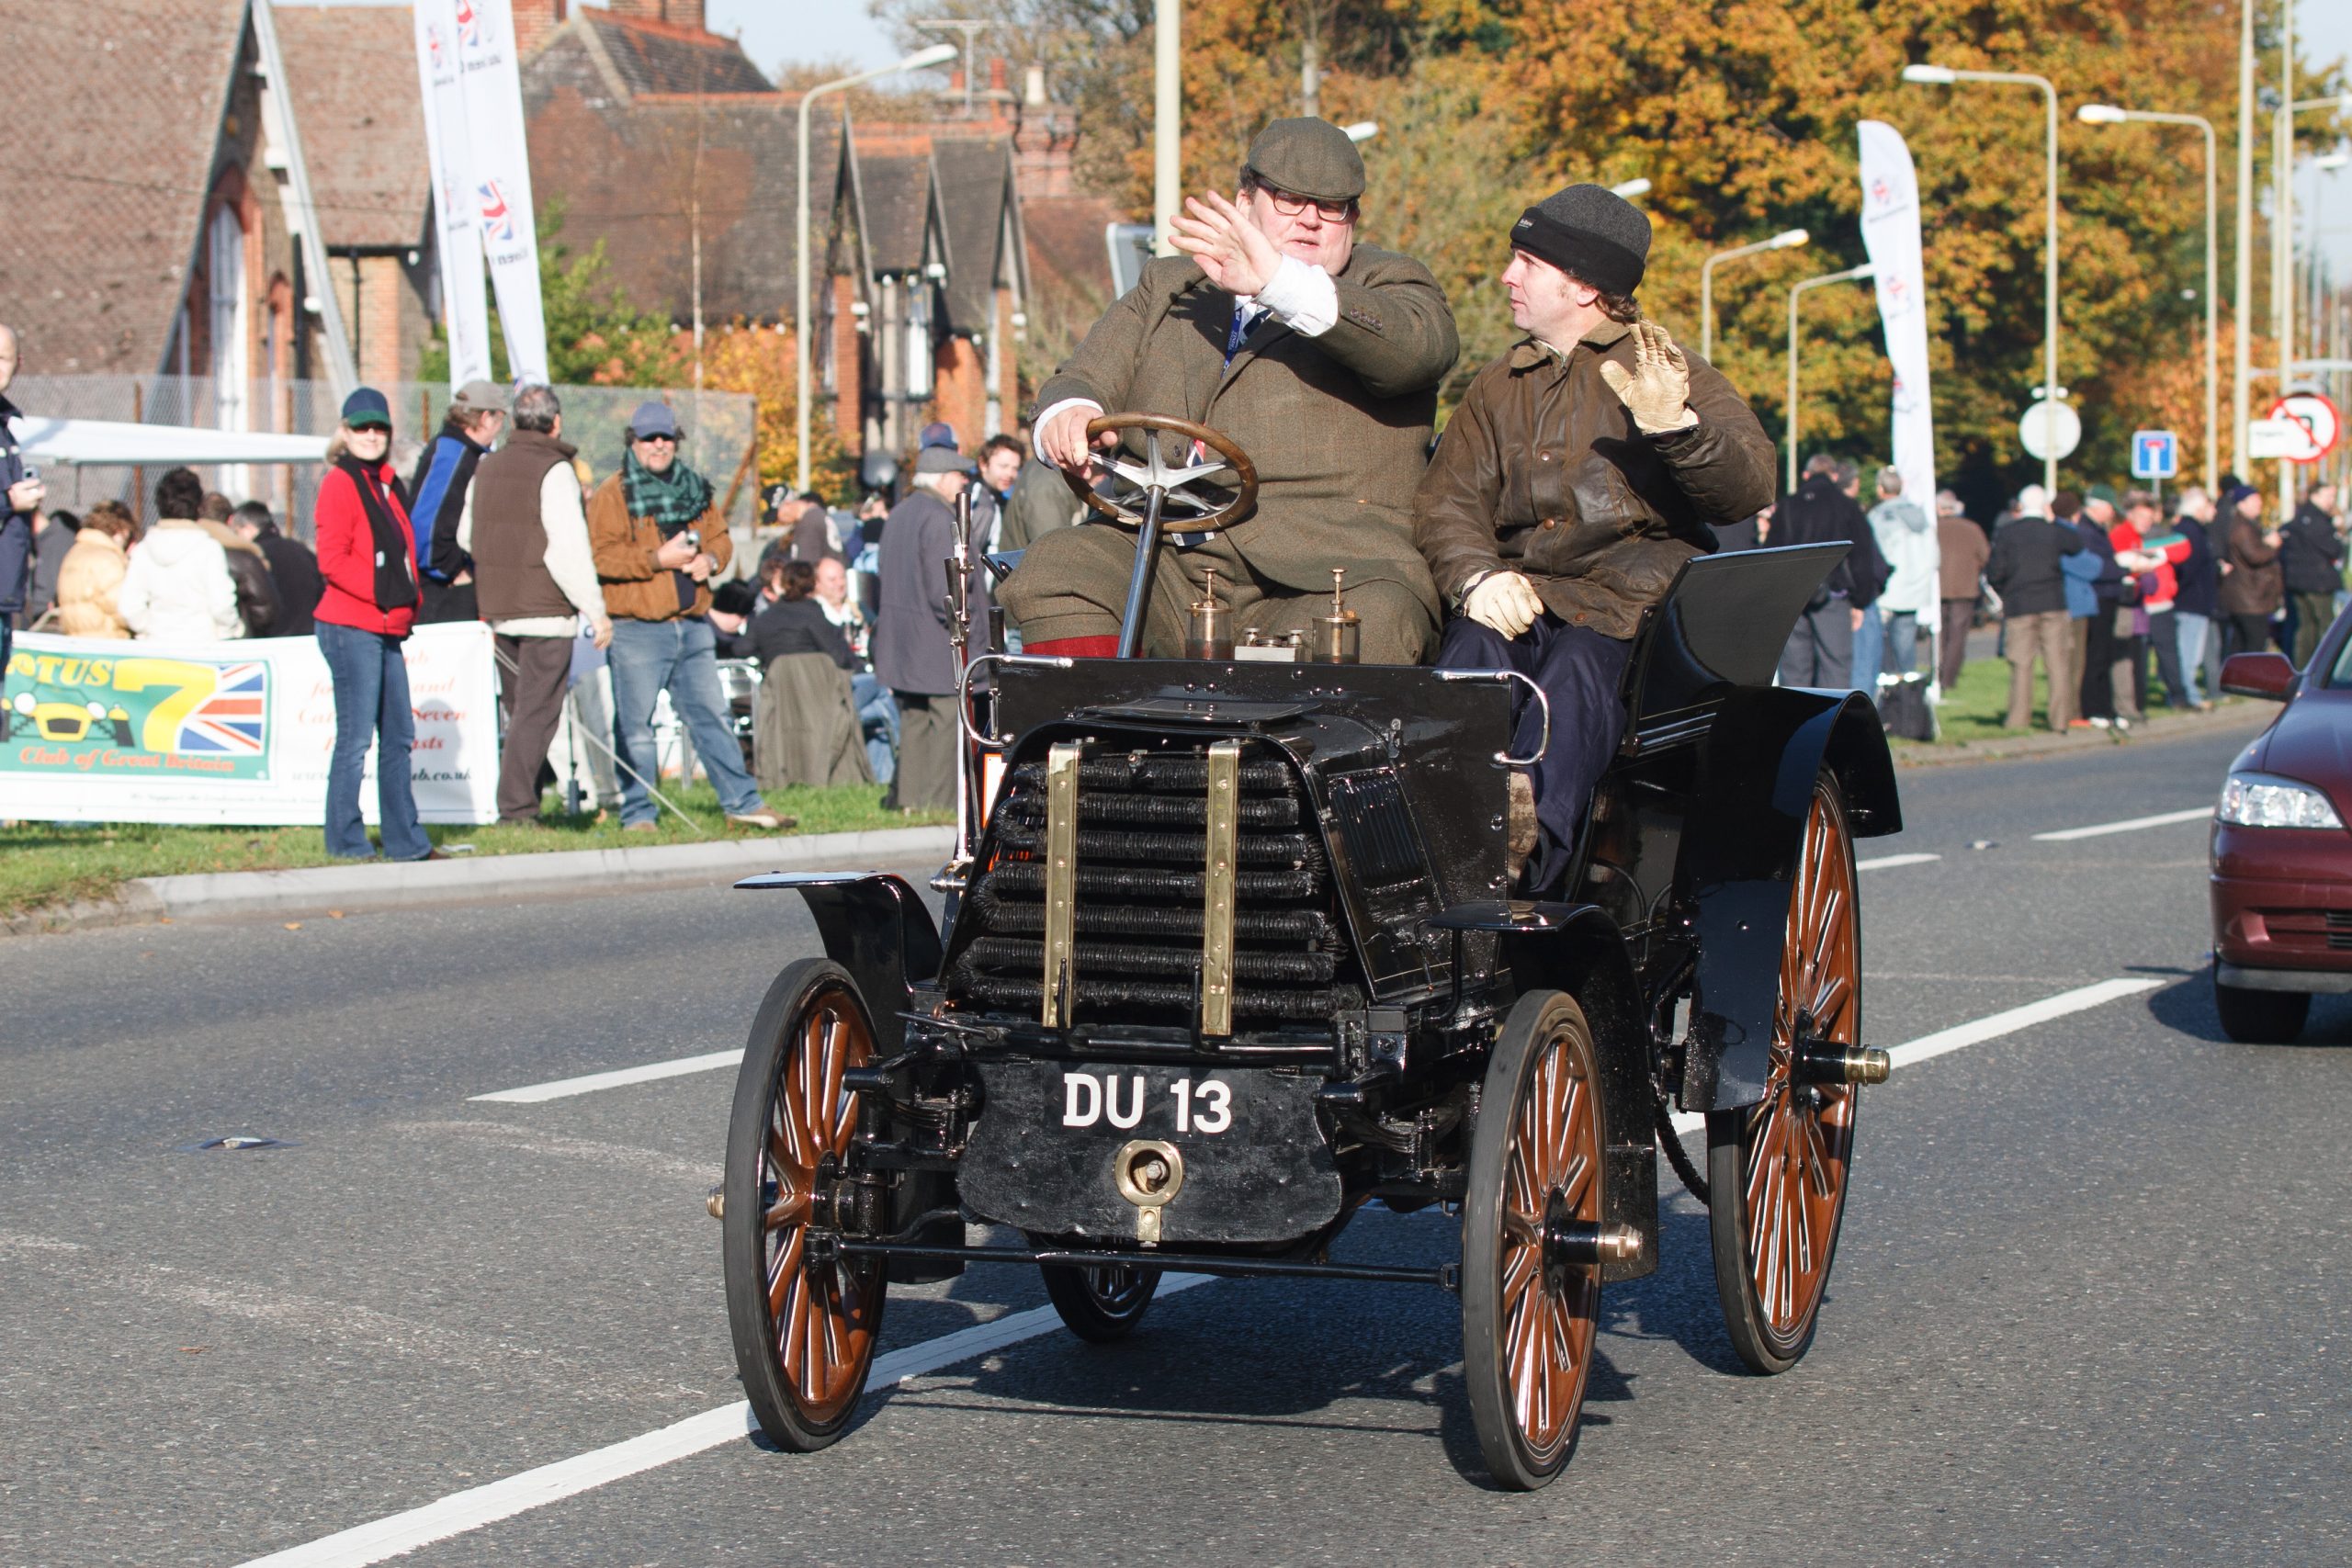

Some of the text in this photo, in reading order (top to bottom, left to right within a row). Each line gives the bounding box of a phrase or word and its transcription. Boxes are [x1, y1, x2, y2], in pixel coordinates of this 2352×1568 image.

[5, 653, 217, 754] OTUS 7
[18, 746, 235, 773] Club of Great Britain
[1063, 1073, 1232, 1134] DU 13
